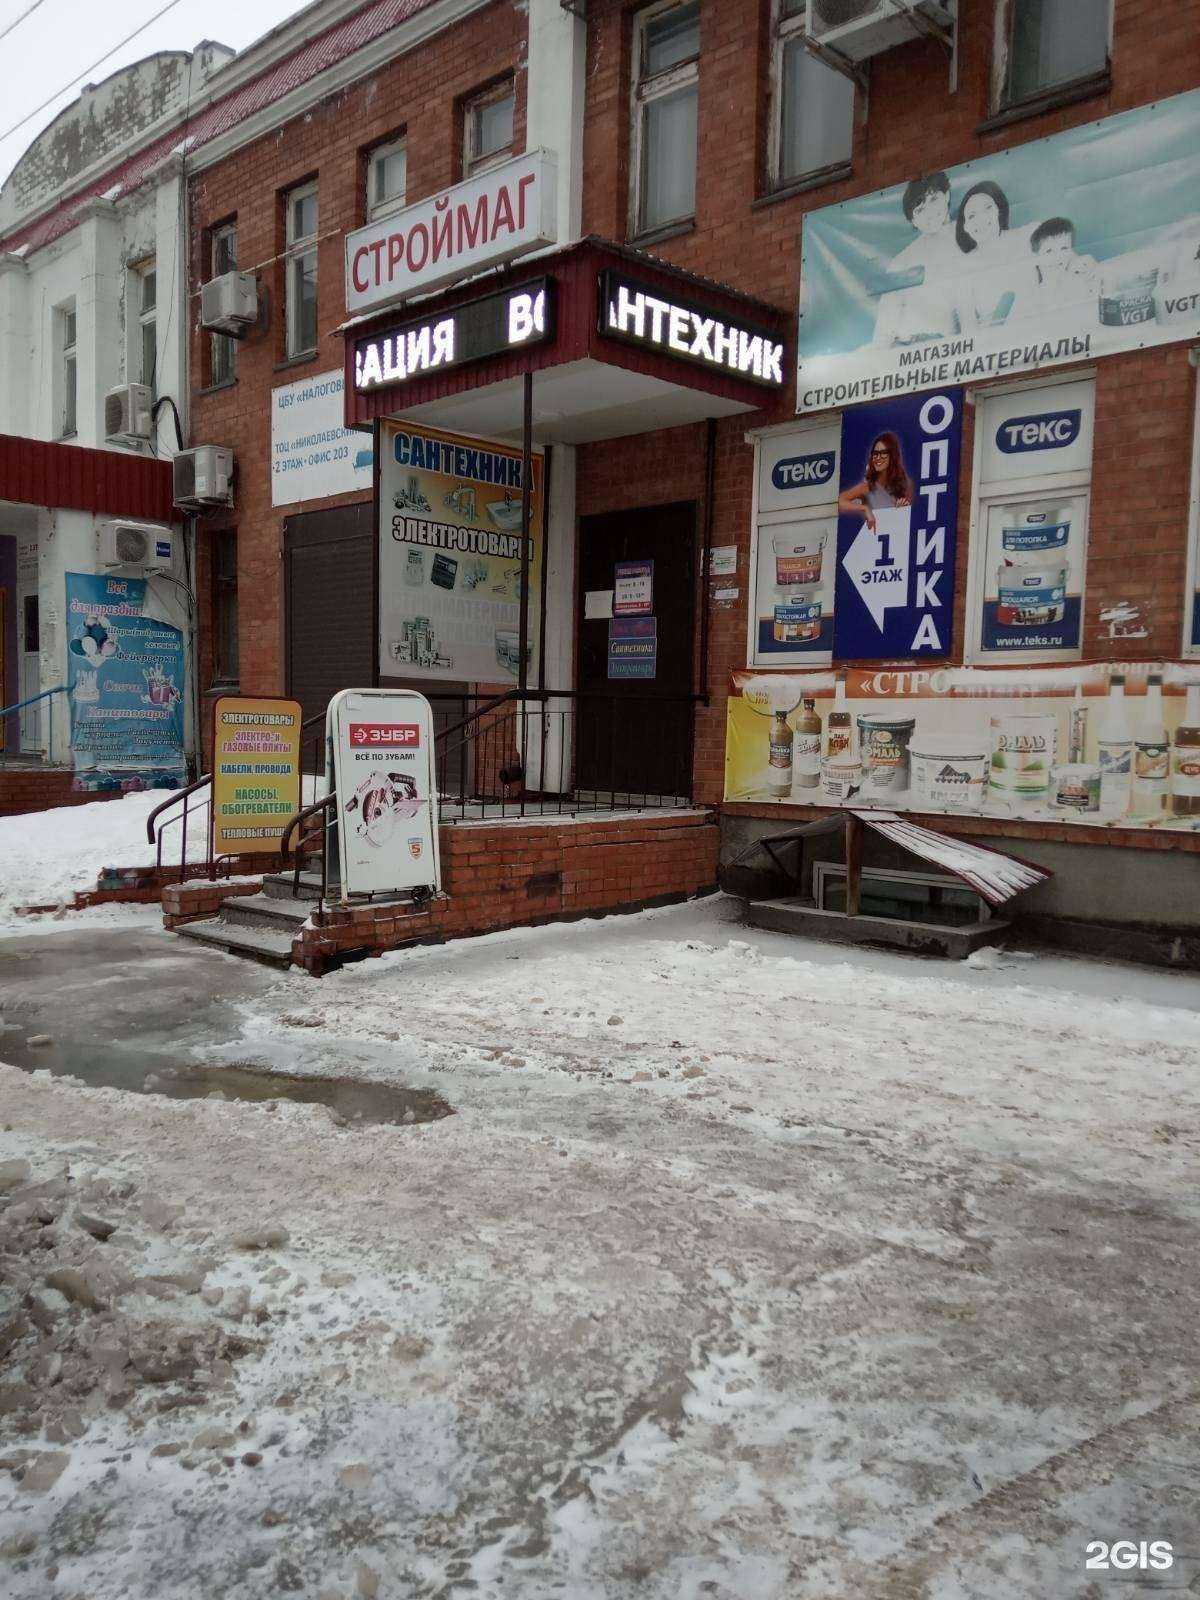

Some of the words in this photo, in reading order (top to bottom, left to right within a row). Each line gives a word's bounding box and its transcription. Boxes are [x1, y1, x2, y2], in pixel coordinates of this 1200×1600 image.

[352, 173, 535, 292] СТРОЙМАГ
[1165, 294, 1199, 314] VGT
[1121, 307, 1150, 324] VGT
[900, 338, 974, 367] МАГАЗИН
[803, 363, 948, 408] СТРОИТЕЛЬНЫЕ
[953, 334, 1091, 378] МАТЕРИАЛЫ
[278, 394, 294, 409] ЦБУ
[297, 379, 344, 402] «НАЛОГОВ
[275, 461, 281, 473] 2
[282, 458, 303, 472] ЭТАЖ
[308, 452, 331, 465] ОФИС
[333, 446, 349, 459] 203
[394, 431, 536, 492] САНТЕХНИК
[910, 395, 954, 650] ОПТИКА
[875, 534, 895, 567] 1
[861, 569, 904, 584] ЭТАЖ
[996, 635, 1062, 648] www.teks.ru
[222, 713, 294, 726] ЭЛЕКТРОТОВАРЫ
[370, 729, 416, 741] ЗУБР
[223, 742, 261, 752] ГАЗОВЫЕ
[262, 743, 291, 752] ПЛИТЫ
[386, 753, 416, 761] ЗУБАМ!
[255, 764, 291, 774] ПРОВОДА
[222, 803, 292, 815] ОБОГРЕВАТЕЛИ
[222, 828, 263, 839] ТЕПЛОВЫЕ
